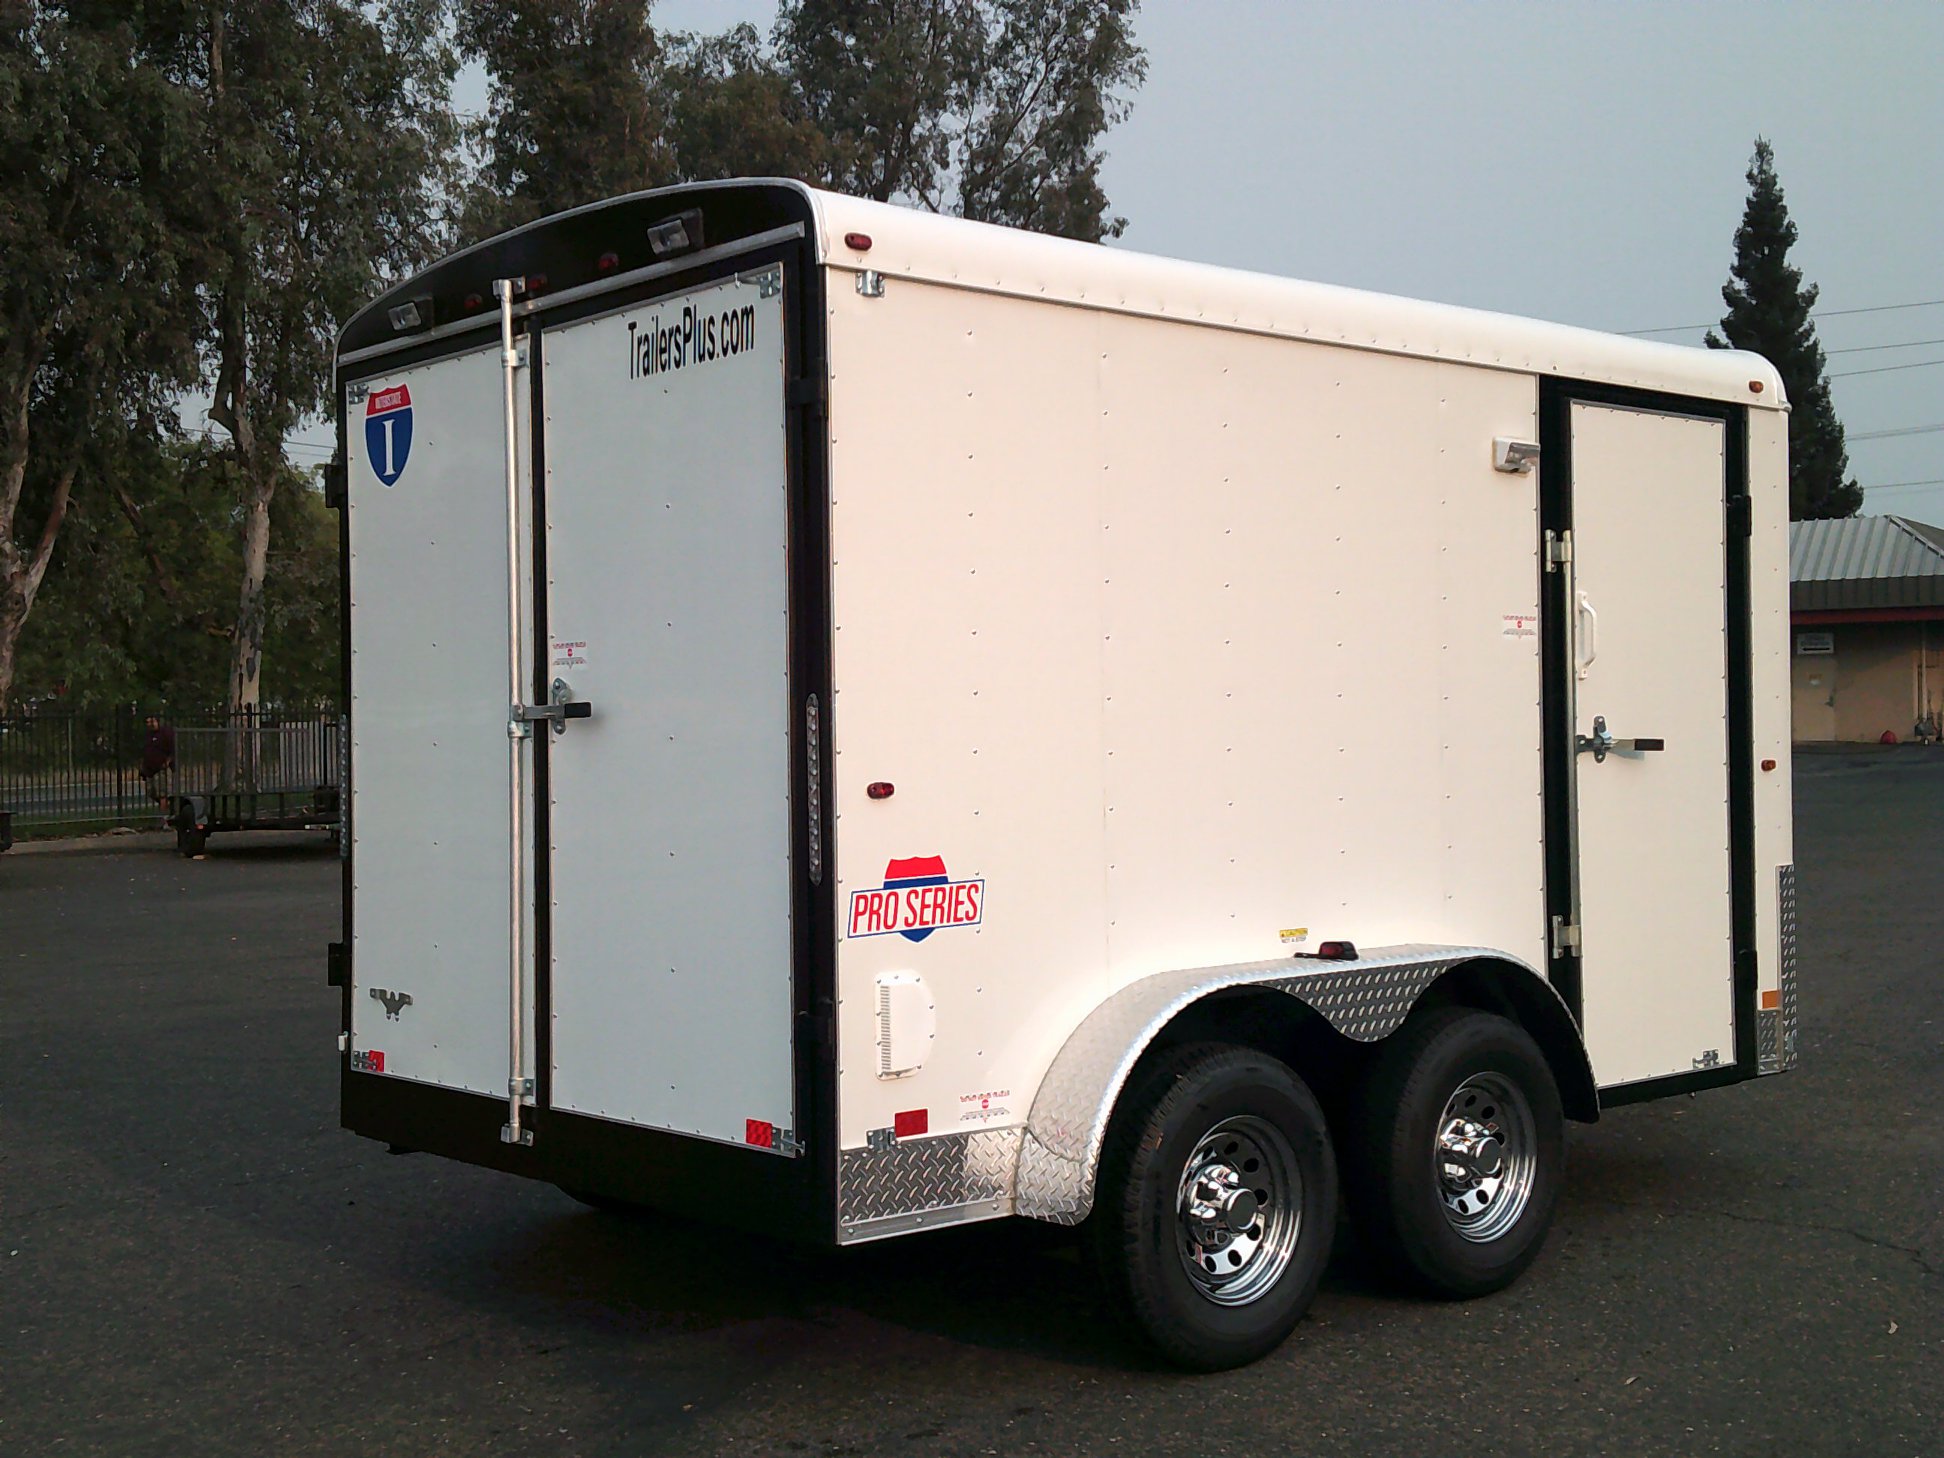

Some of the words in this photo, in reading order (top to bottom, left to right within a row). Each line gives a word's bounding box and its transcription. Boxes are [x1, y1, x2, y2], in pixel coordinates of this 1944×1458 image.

[628, 303, 755, 380] TrailersPlus.com
[852, 891, 899, 933] PRO
[904, 883, 980, 928] SERIES
